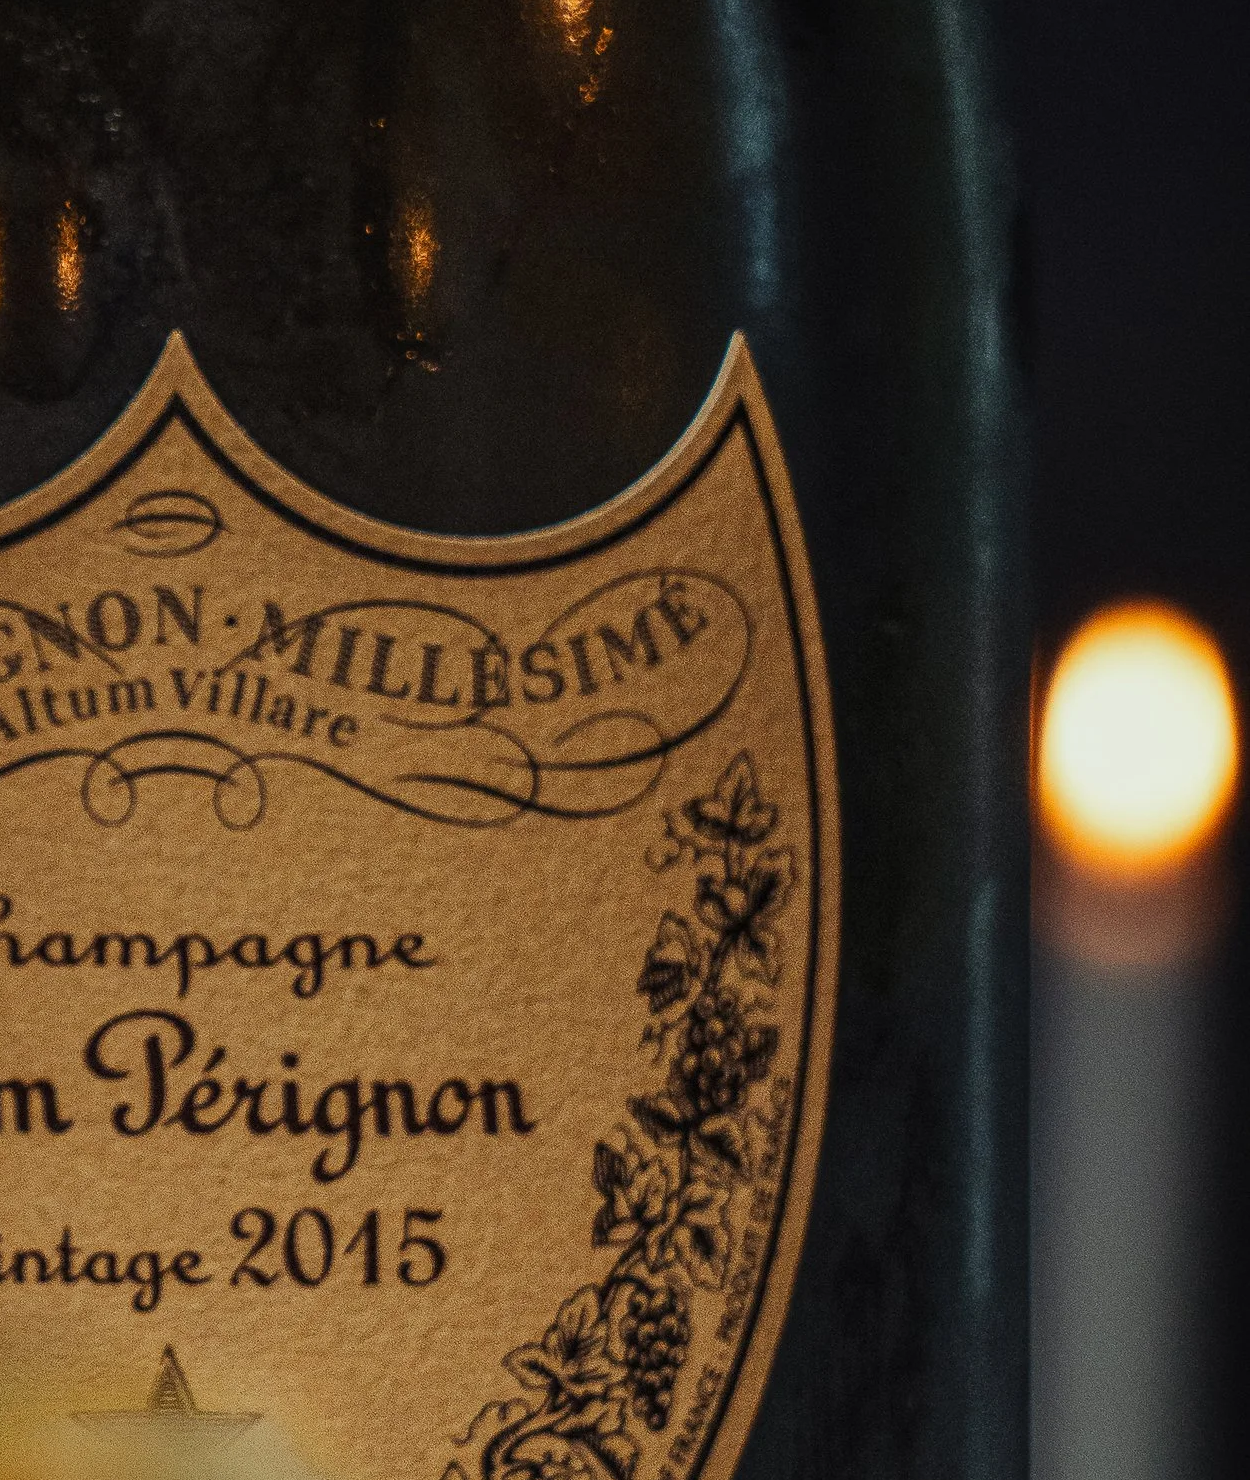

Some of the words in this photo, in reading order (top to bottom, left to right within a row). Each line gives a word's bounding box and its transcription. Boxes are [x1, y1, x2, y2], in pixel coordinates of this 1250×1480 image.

[170, 666, 358, 748] Villare
[83, 1007, 538, 1183] Pérignon
[229, 1205, 447, 1288] 2015
